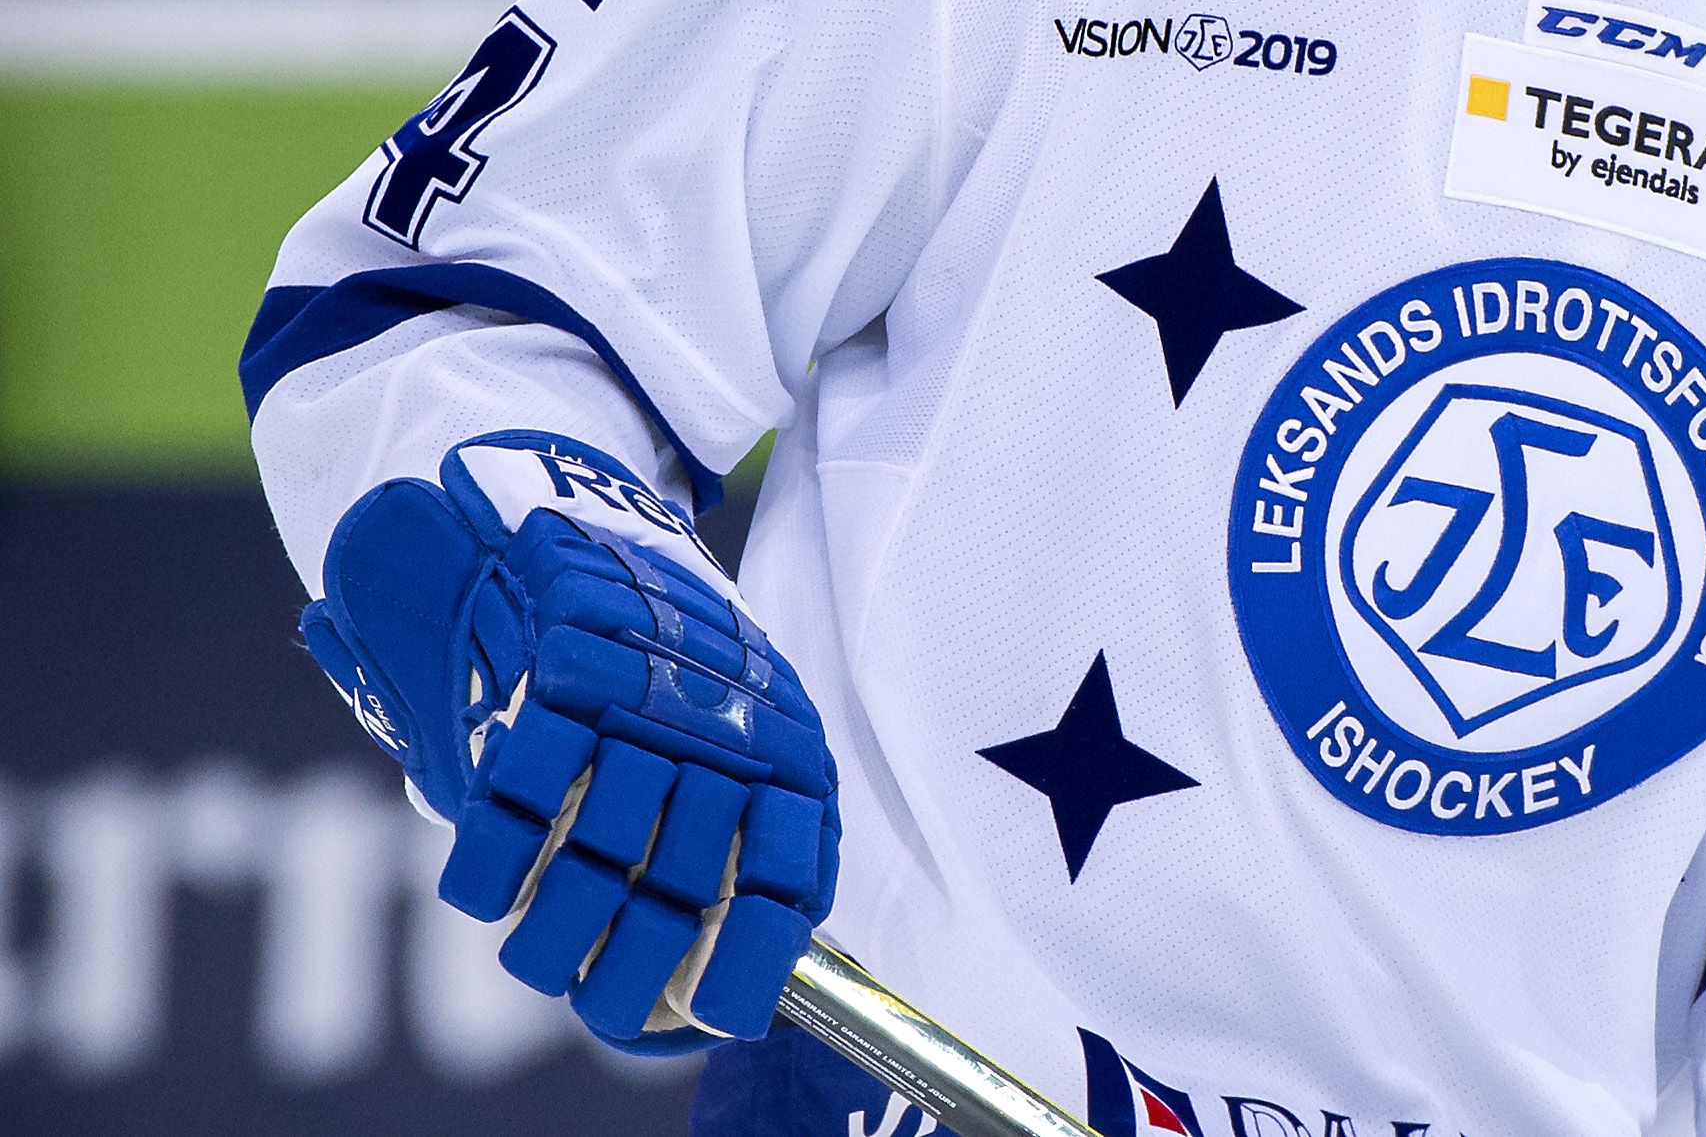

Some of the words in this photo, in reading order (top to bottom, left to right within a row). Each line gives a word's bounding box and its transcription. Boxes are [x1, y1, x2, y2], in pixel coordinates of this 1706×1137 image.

[1054, 18, 1173, 58] VISION
[1233, 30, 1338, 76] 2019
[1551, 139, 1582, 177] by
[1591, 153, 1699, 204] ejendals
[1251, 299, 1443, 573] LEKSANDS
[1305, 700, 1597, 820] ISHOCKEY
